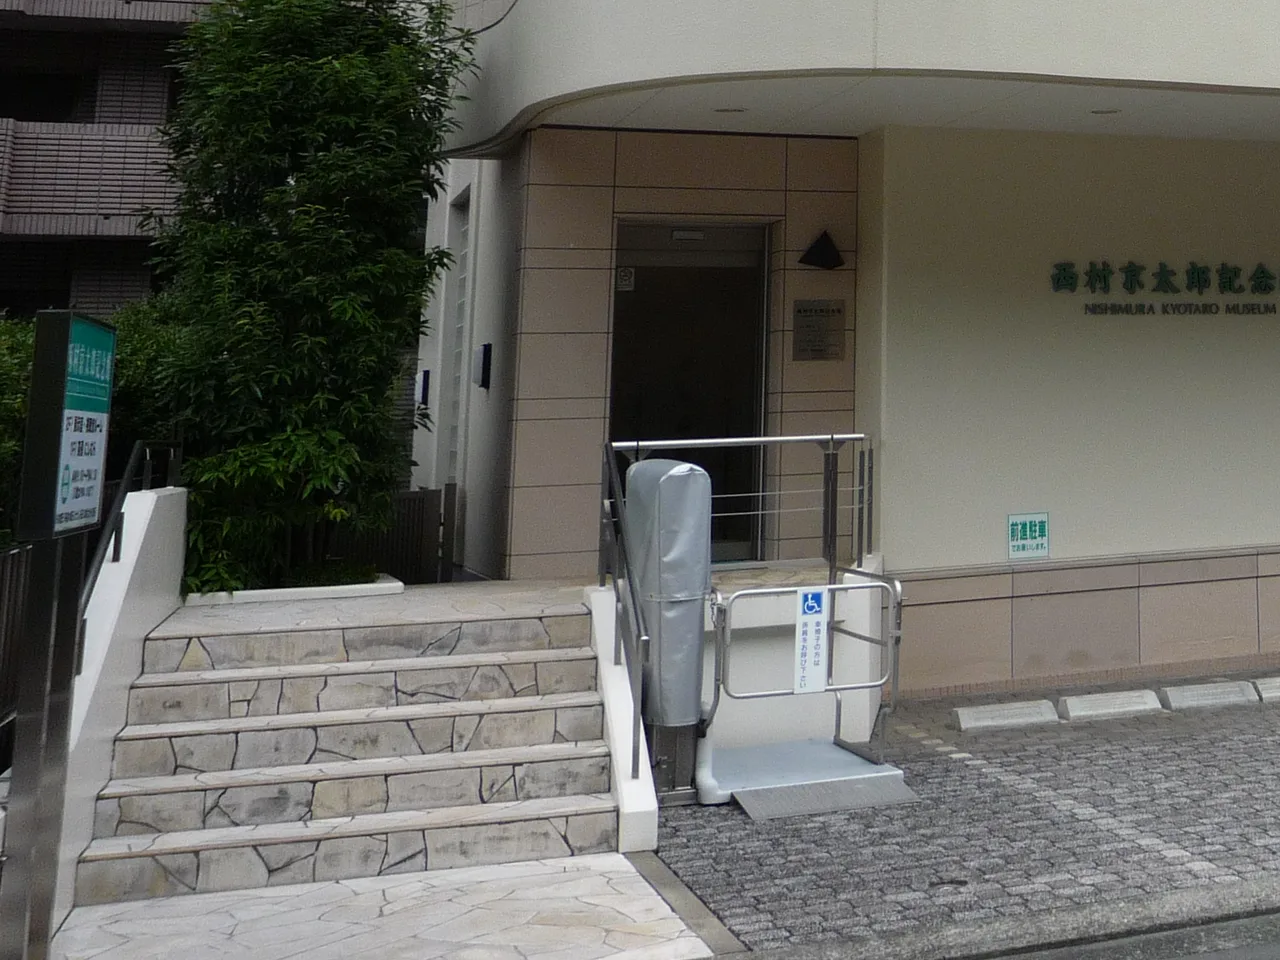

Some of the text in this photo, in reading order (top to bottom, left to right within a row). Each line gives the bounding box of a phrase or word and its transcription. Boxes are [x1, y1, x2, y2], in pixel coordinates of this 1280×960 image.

[1085, 303, 1277, 315] NISHIMURA KYOTARO MUSEUM
[1010, 520, 1047, 542] 前進駐車
